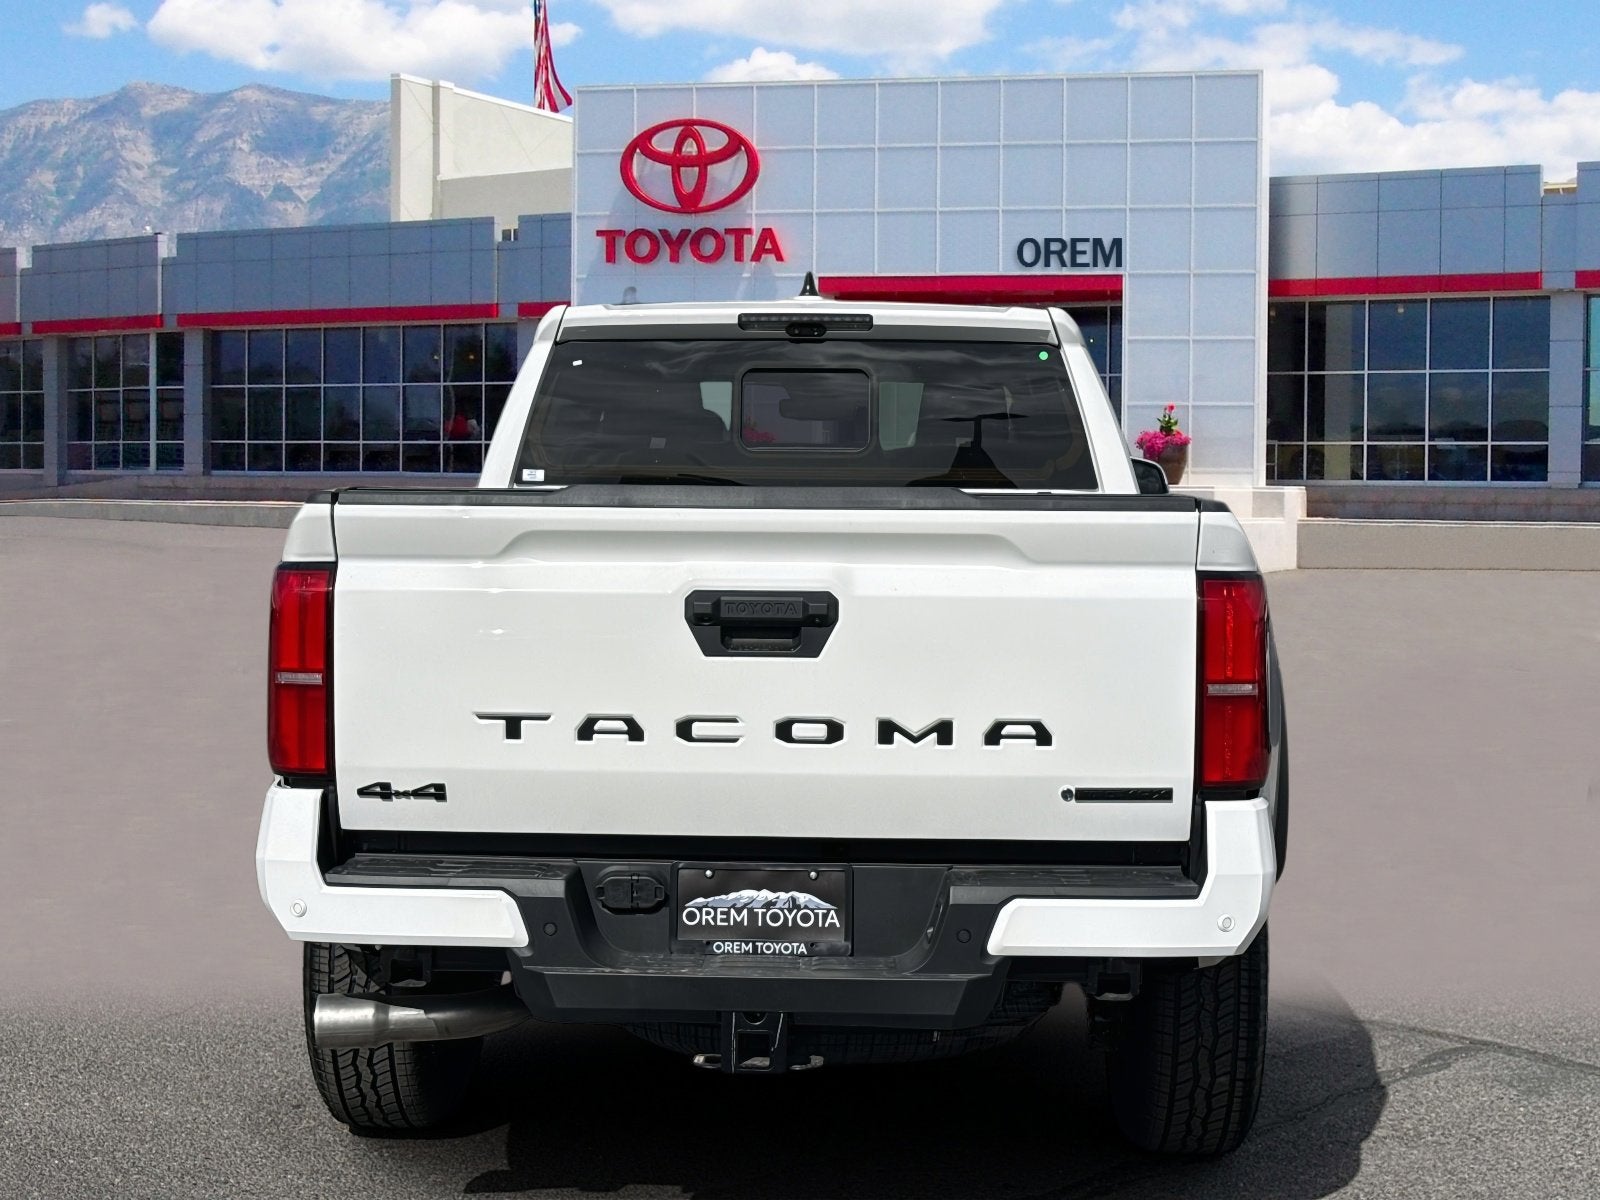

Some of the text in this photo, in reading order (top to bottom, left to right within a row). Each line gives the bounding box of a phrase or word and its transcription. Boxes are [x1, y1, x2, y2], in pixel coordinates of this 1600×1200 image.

[596, 227, 785, 263] TOYOTA
[1016, 237, 1123, 268] OREM
[725, 602, 798, 616] TOYOTA
[474, 712, 1053, 746] TACOMA
[682, 907, 841, 928] OREM TOYOTA
[713, 941, 808, 955] OREM TOYOTA
